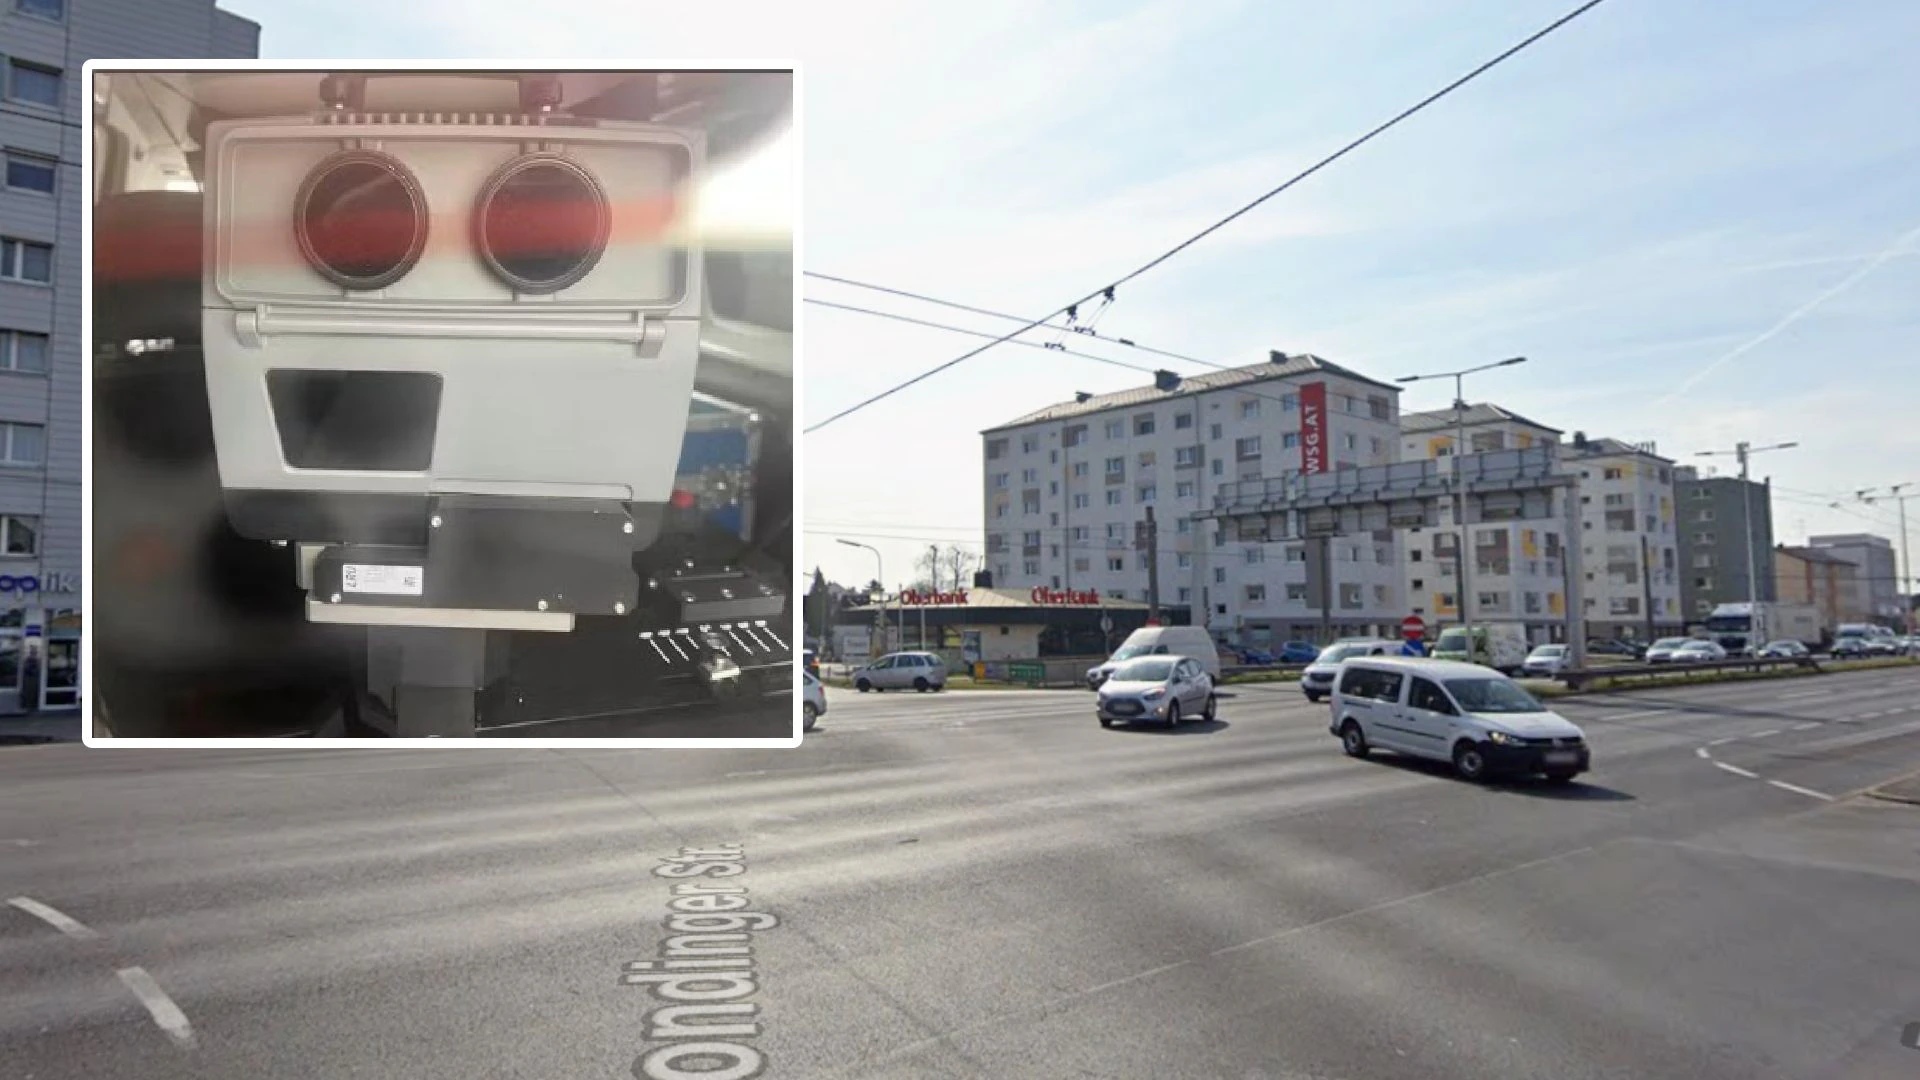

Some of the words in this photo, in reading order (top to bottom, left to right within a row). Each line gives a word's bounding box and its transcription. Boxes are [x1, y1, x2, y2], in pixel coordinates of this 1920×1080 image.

[1305, 405, 1320, 475] WSG.AT
[900, 588, 969, 605] Oberbank
[1032, 586, 1099, 605] Oberbank
